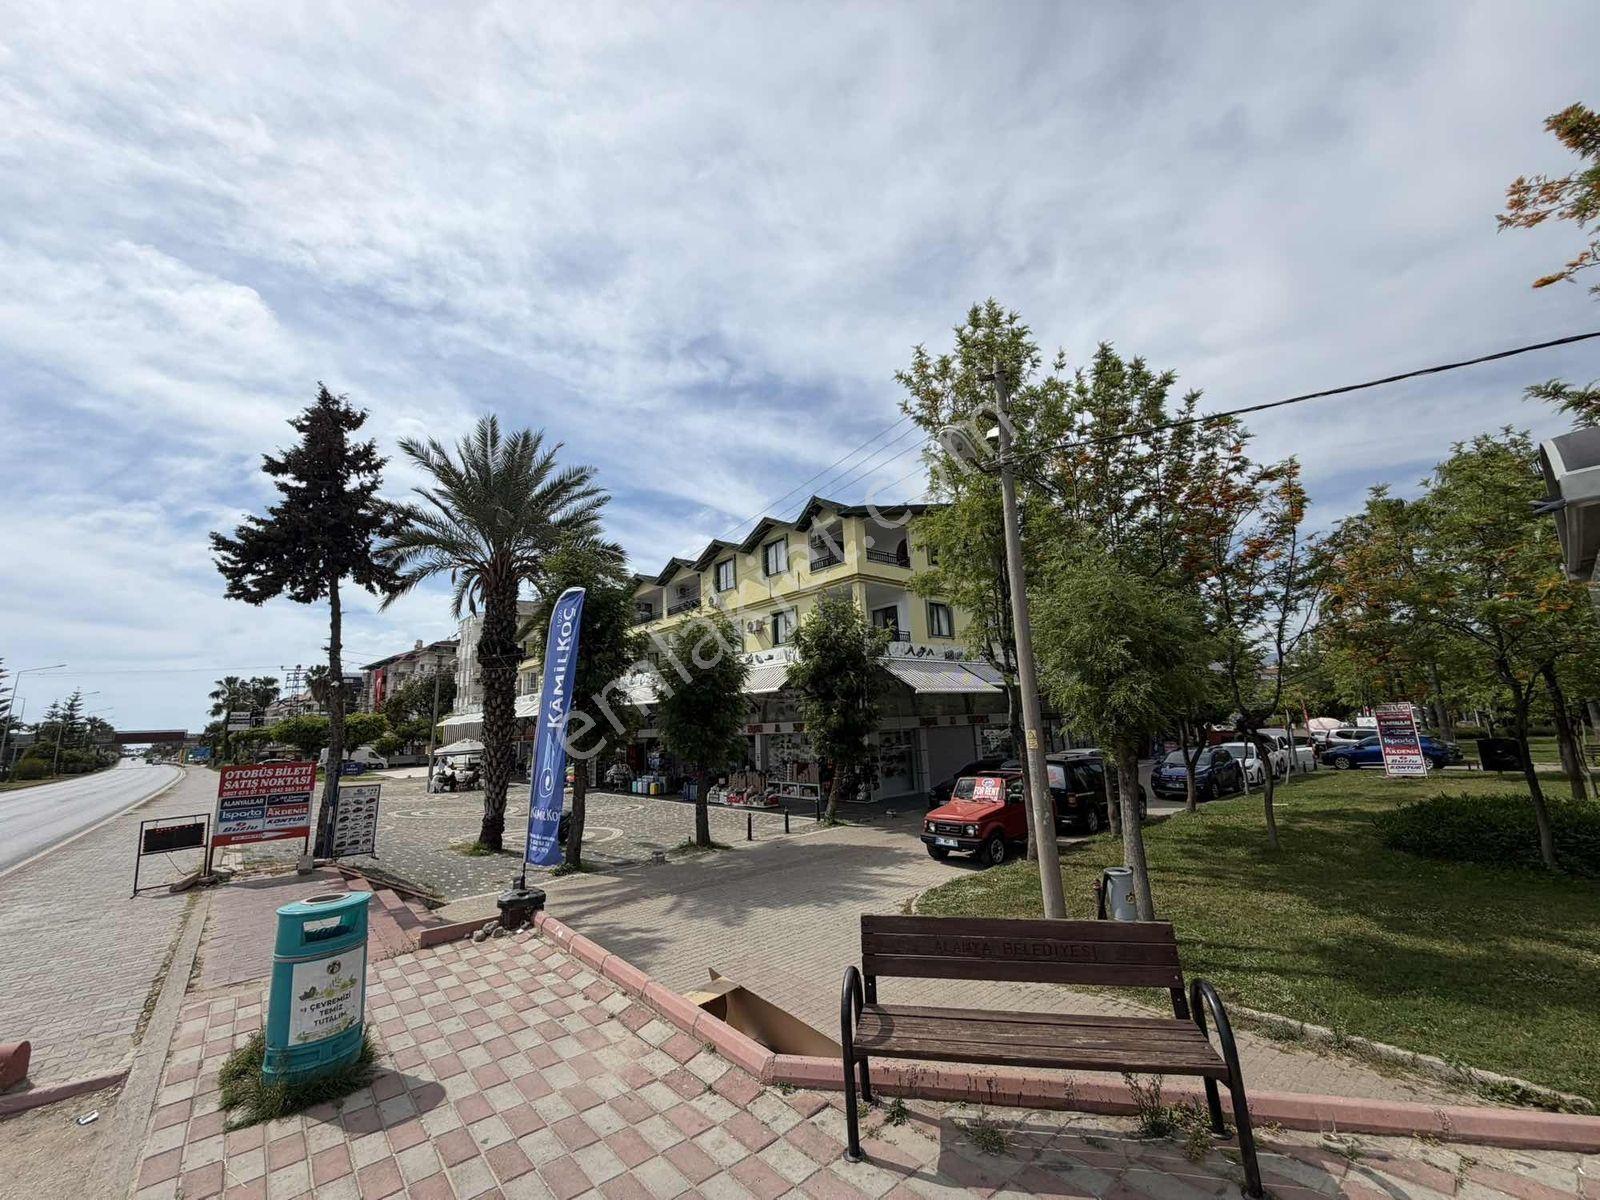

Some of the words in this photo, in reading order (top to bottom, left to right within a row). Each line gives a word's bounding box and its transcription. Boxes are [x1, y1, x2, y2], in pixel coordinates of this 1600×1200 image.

[225, 768, 273, 779] OTOBÜS
[275, 766, 312, 776] BİLETİ
[223, 779, 260, 790] SATIŞ
[260, 776, 311, 787] NOKTASI
[310, 991, 351, 1012] ÇEVREMİZİ
[320, 1003, 343, 1016] TEMİZ
[313, 1010, 347, 1026] TUTALIM
